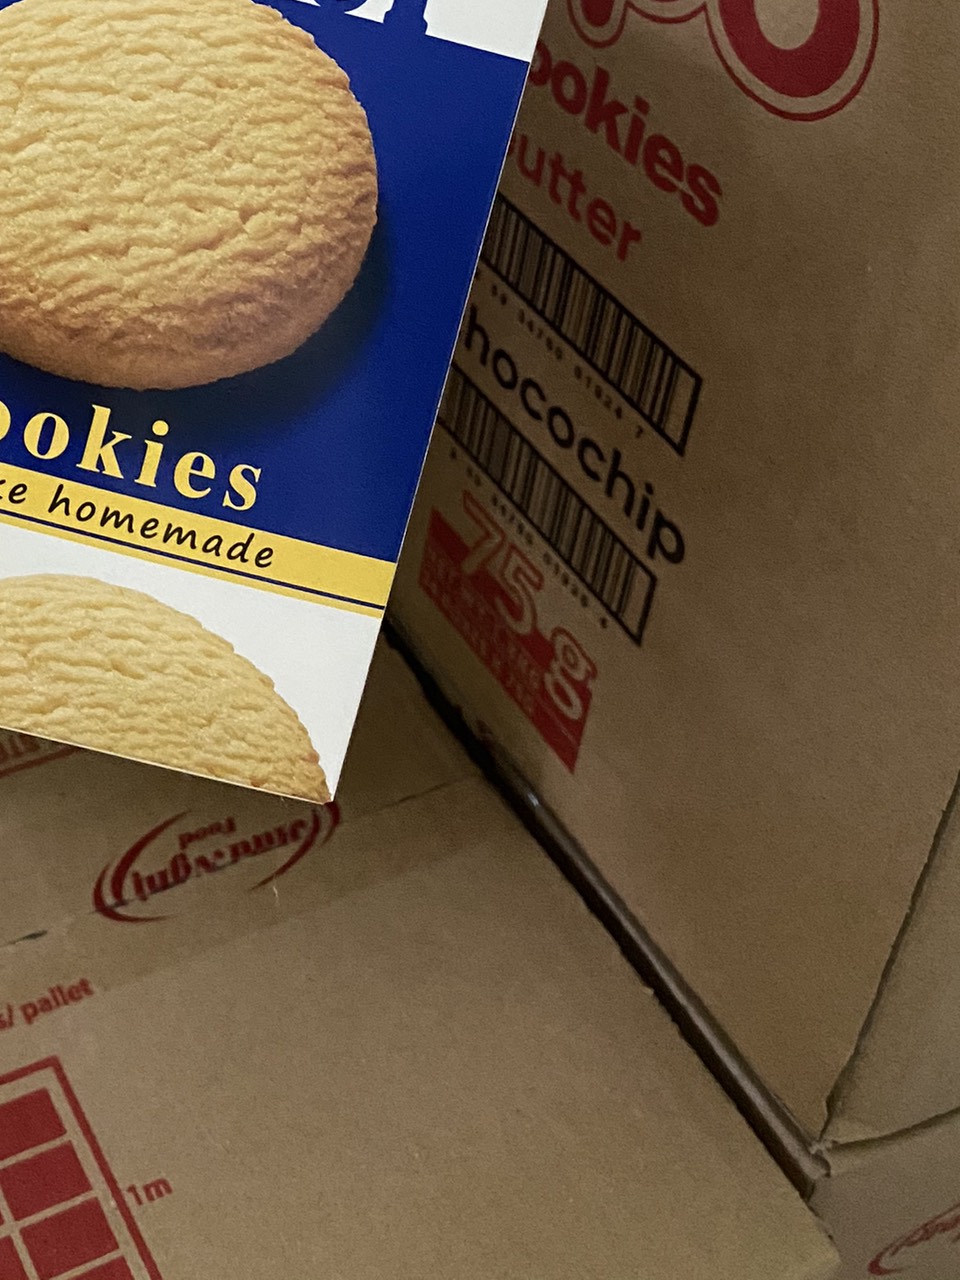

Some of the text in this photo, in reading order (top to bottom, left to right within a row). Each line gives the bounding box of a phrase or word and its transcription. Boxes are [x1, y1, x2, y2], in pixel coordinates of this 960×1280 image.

[464, 302, 686, 564] hocochip
[48, 483, 276, 570] homemade
[20, 977, 94, 1026] pallet
[126, 1178, 174, 1206] 1m
